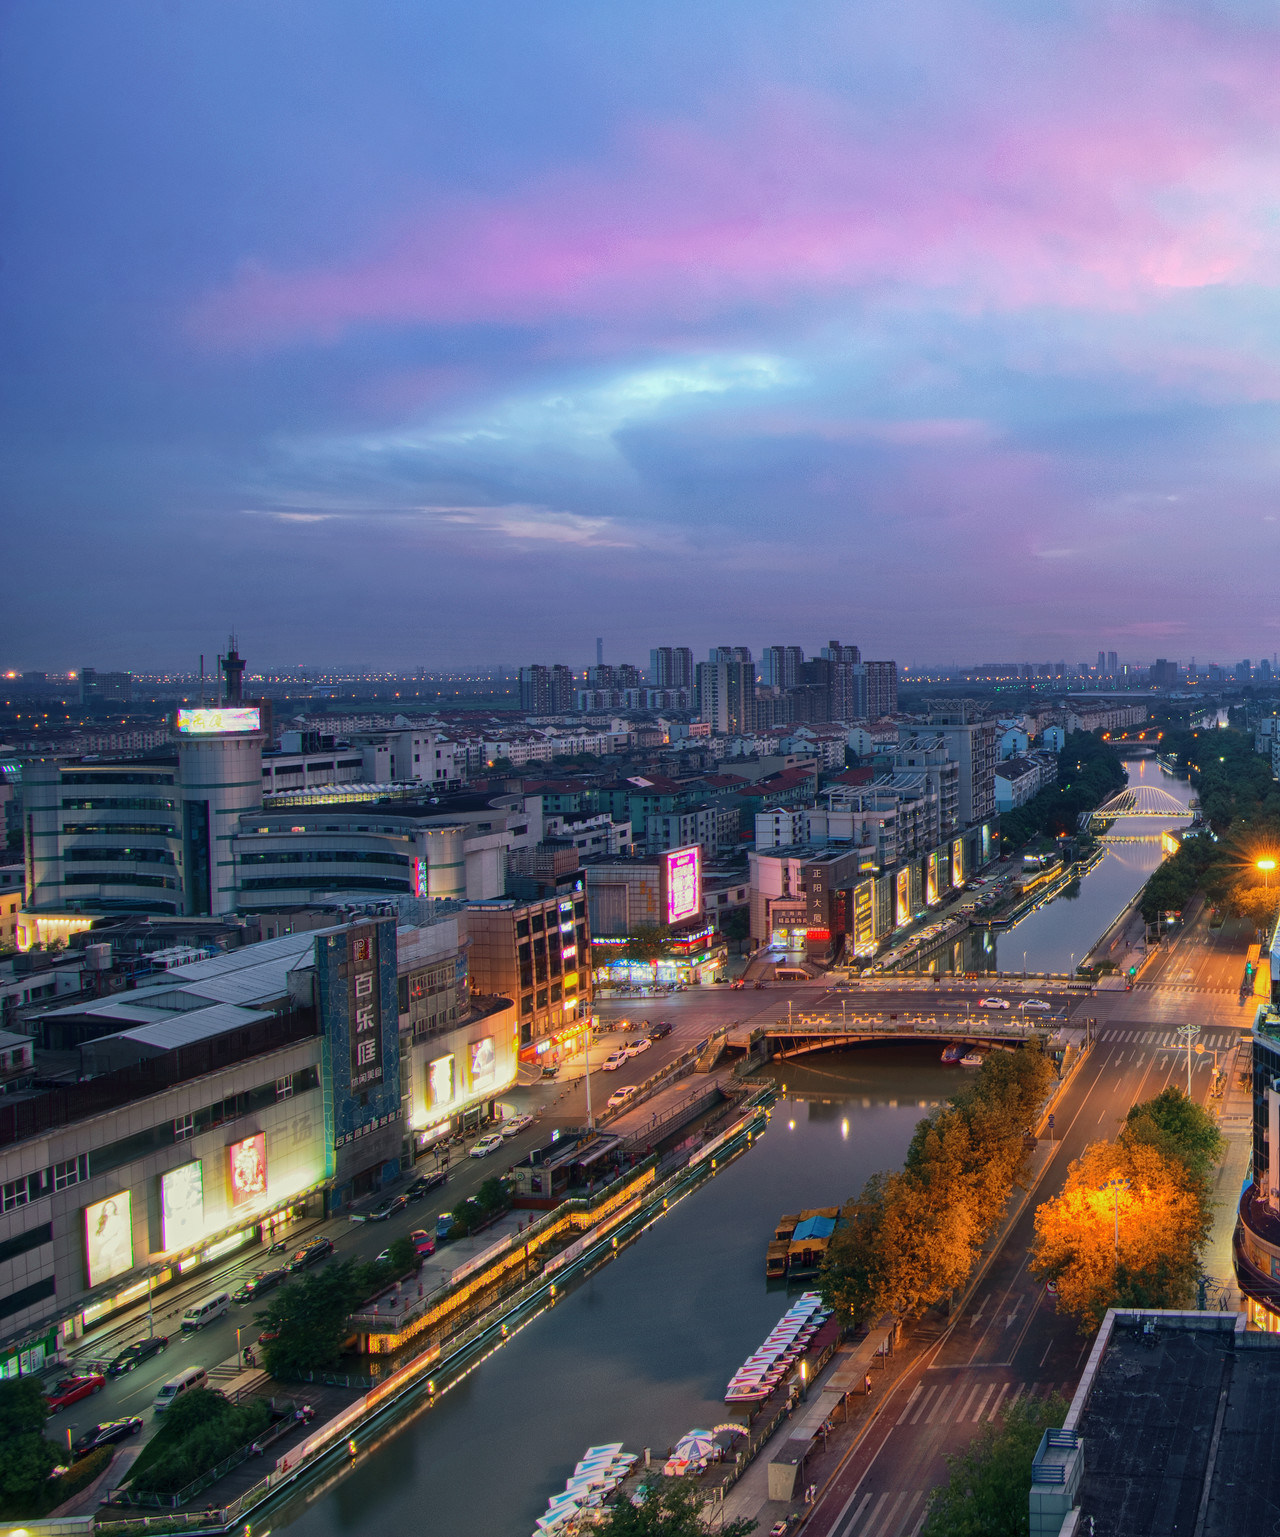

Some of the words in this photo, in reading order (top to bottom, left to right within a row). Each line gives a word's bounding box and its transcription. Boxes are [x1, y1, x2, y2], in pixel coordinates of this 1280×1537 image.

[812, 869, 822, 923] 正阳大厦
[354, 970, 376, 1067] 百乐庭
